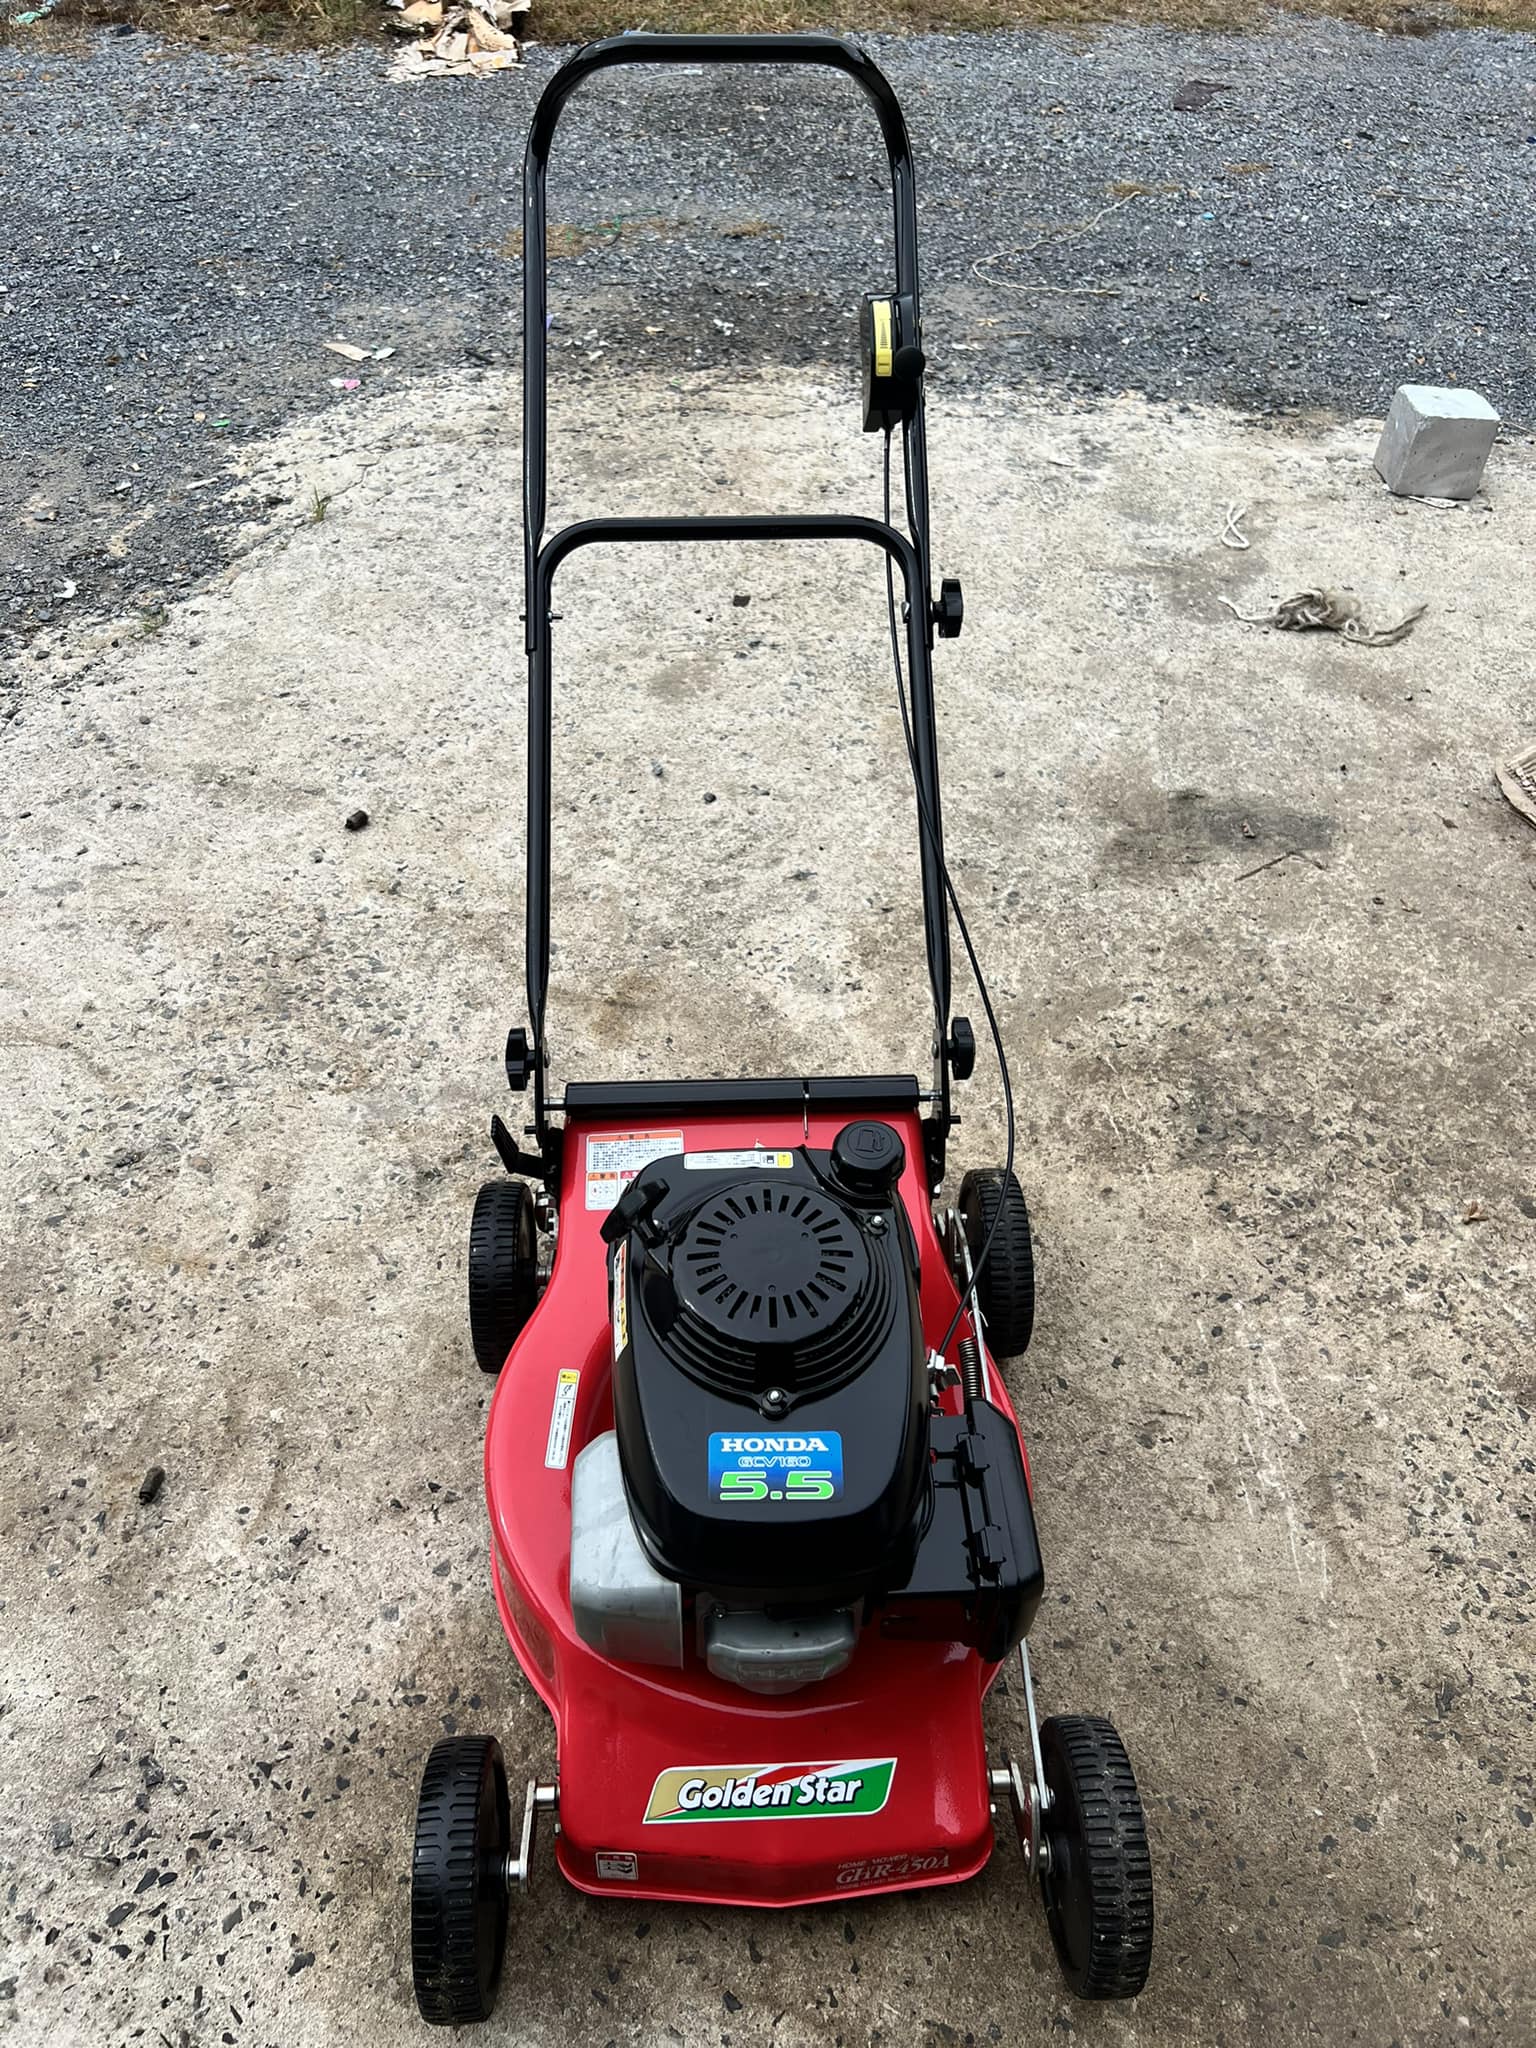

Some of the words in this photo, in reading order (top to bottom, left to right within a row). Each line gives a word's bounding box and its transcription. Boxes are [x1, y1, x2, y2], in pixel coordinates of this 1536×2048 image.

[720, 1438, 829, 1452] HONDA
[738, 1456, 812, 1468] GCV160
[719, 1470, 835, 1501] 5.5
[677, 1778, 792, 1810] Golden
[796, 1775, 863, 1805] Star
